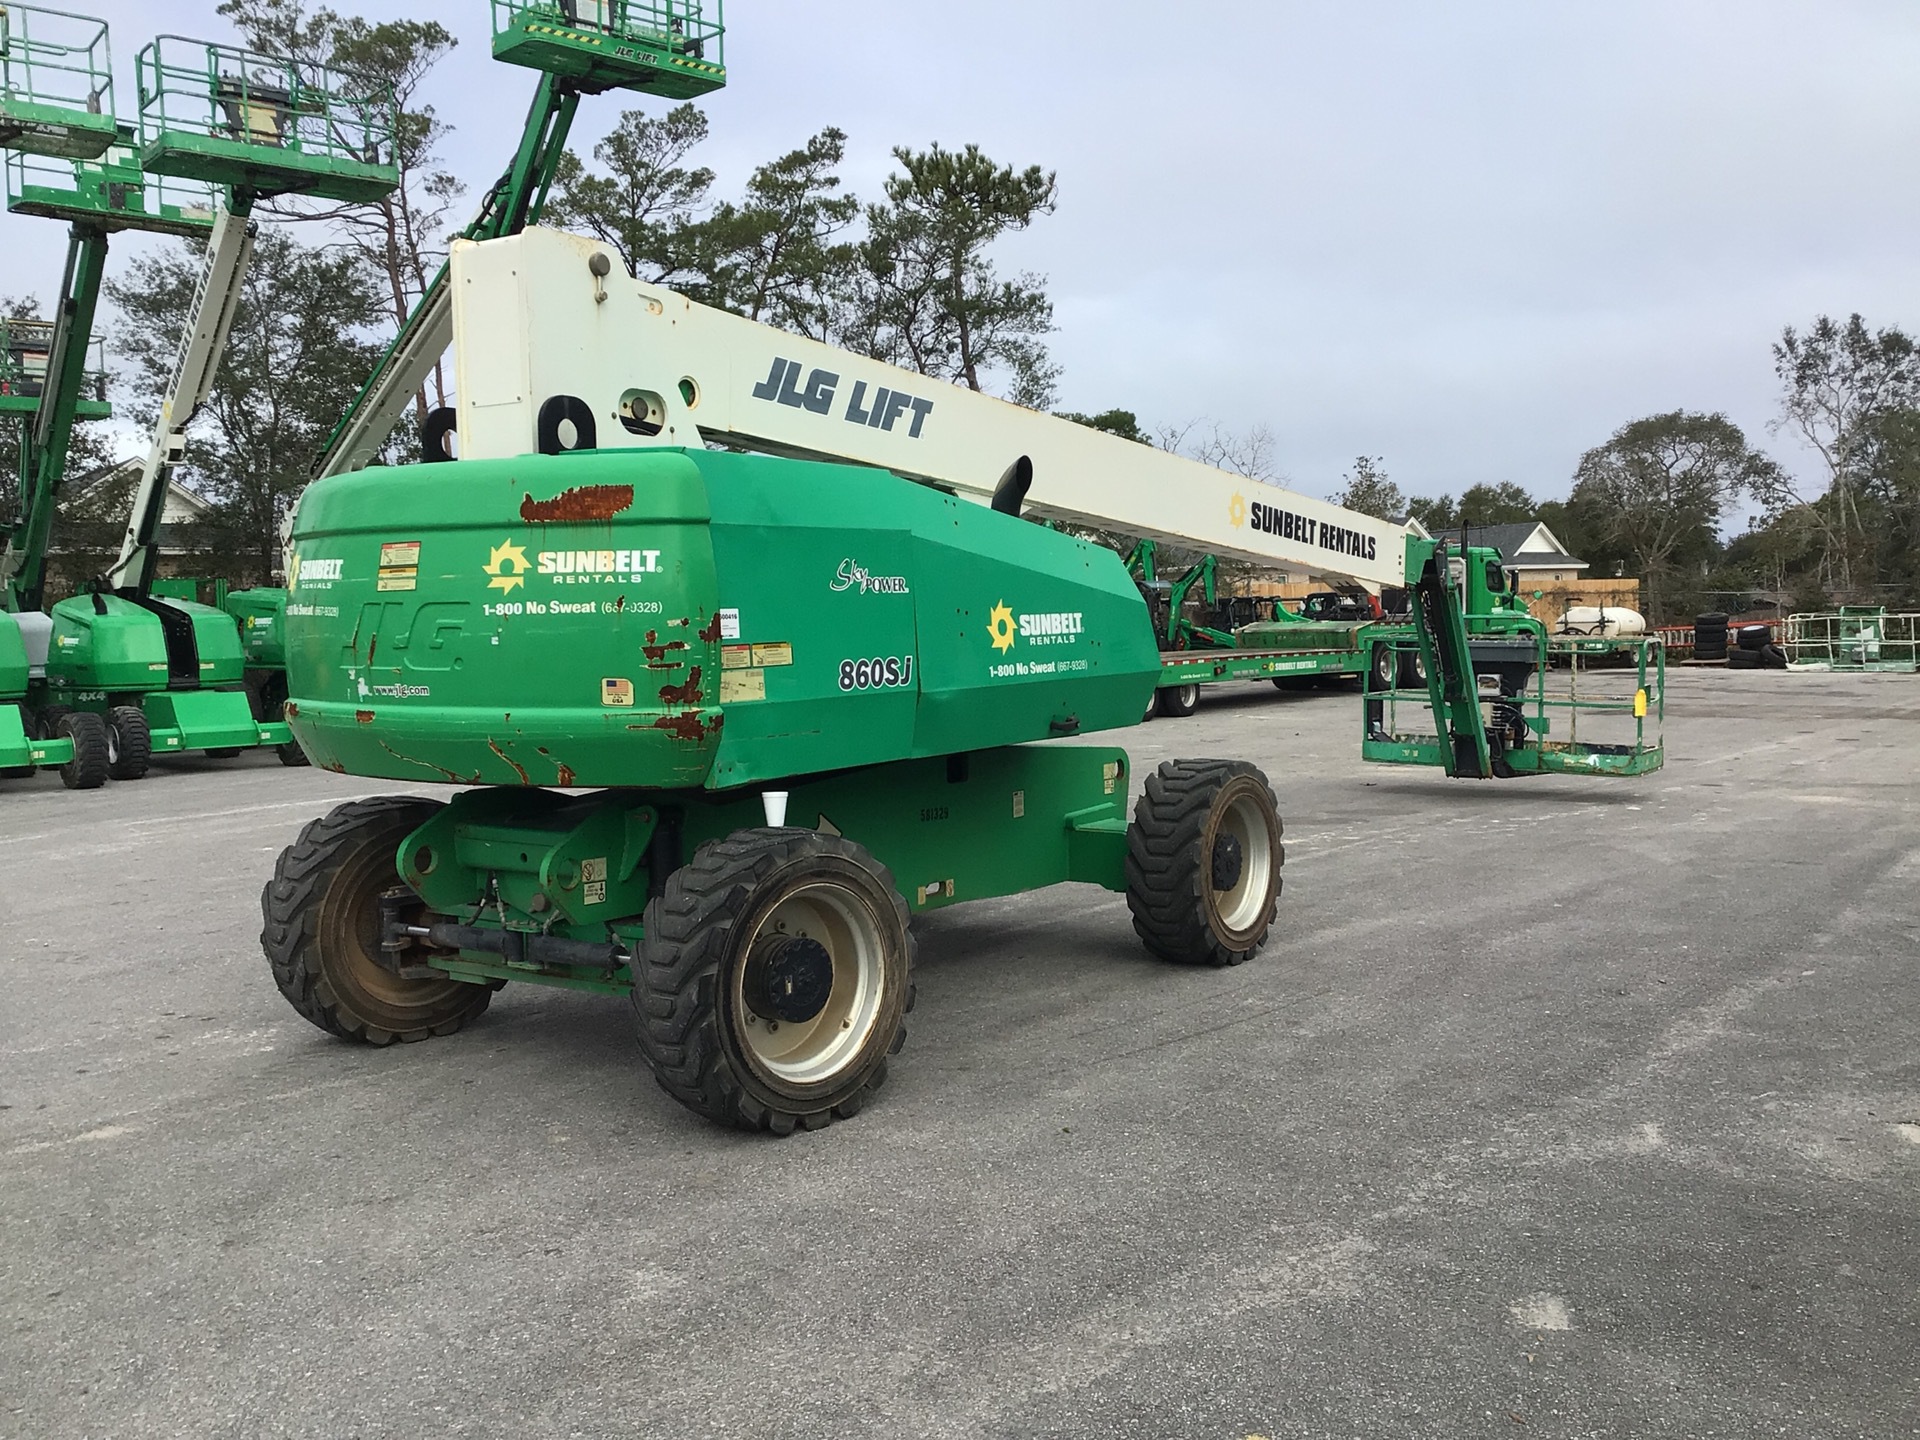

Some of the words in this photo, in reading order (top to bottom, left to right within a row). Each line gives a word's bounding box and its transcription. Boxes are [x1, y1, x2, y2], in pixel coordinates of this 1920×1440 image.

[614, 46, 634, 59] JLG
[636, 51, 659, 65] LIFT
[169, 324, 193, 400] SUNBELT
[189, 246, 216, 326] RENTALS
[751, 356, 841, 416] JLG
[844, 379, 935, 439] LIFT
[1250, 501, 1317, 545] SUNBELT
[1319, 521, 1376, 561] RENTALS
[299, 559, 343, 580] SUNBELT
[537, 550, 661, 574] SUNBELT
[553, 574, 642, 585] RENTALS
[483, 603, 522, 616] 1-800
[526, 601, 546, 614] No
[549, 600, 596, 614] Sweat
[1019, 612, 1083, 636] SUNBELT
[1029, 635, 1076, 646] RENTALS
[838, 656, 913, 691] 860SJ
[989, 665, 1015, 677] 1-800
[1016, 662, 1029, 675] No
[1029, 661, 1056, 674] Sweat
